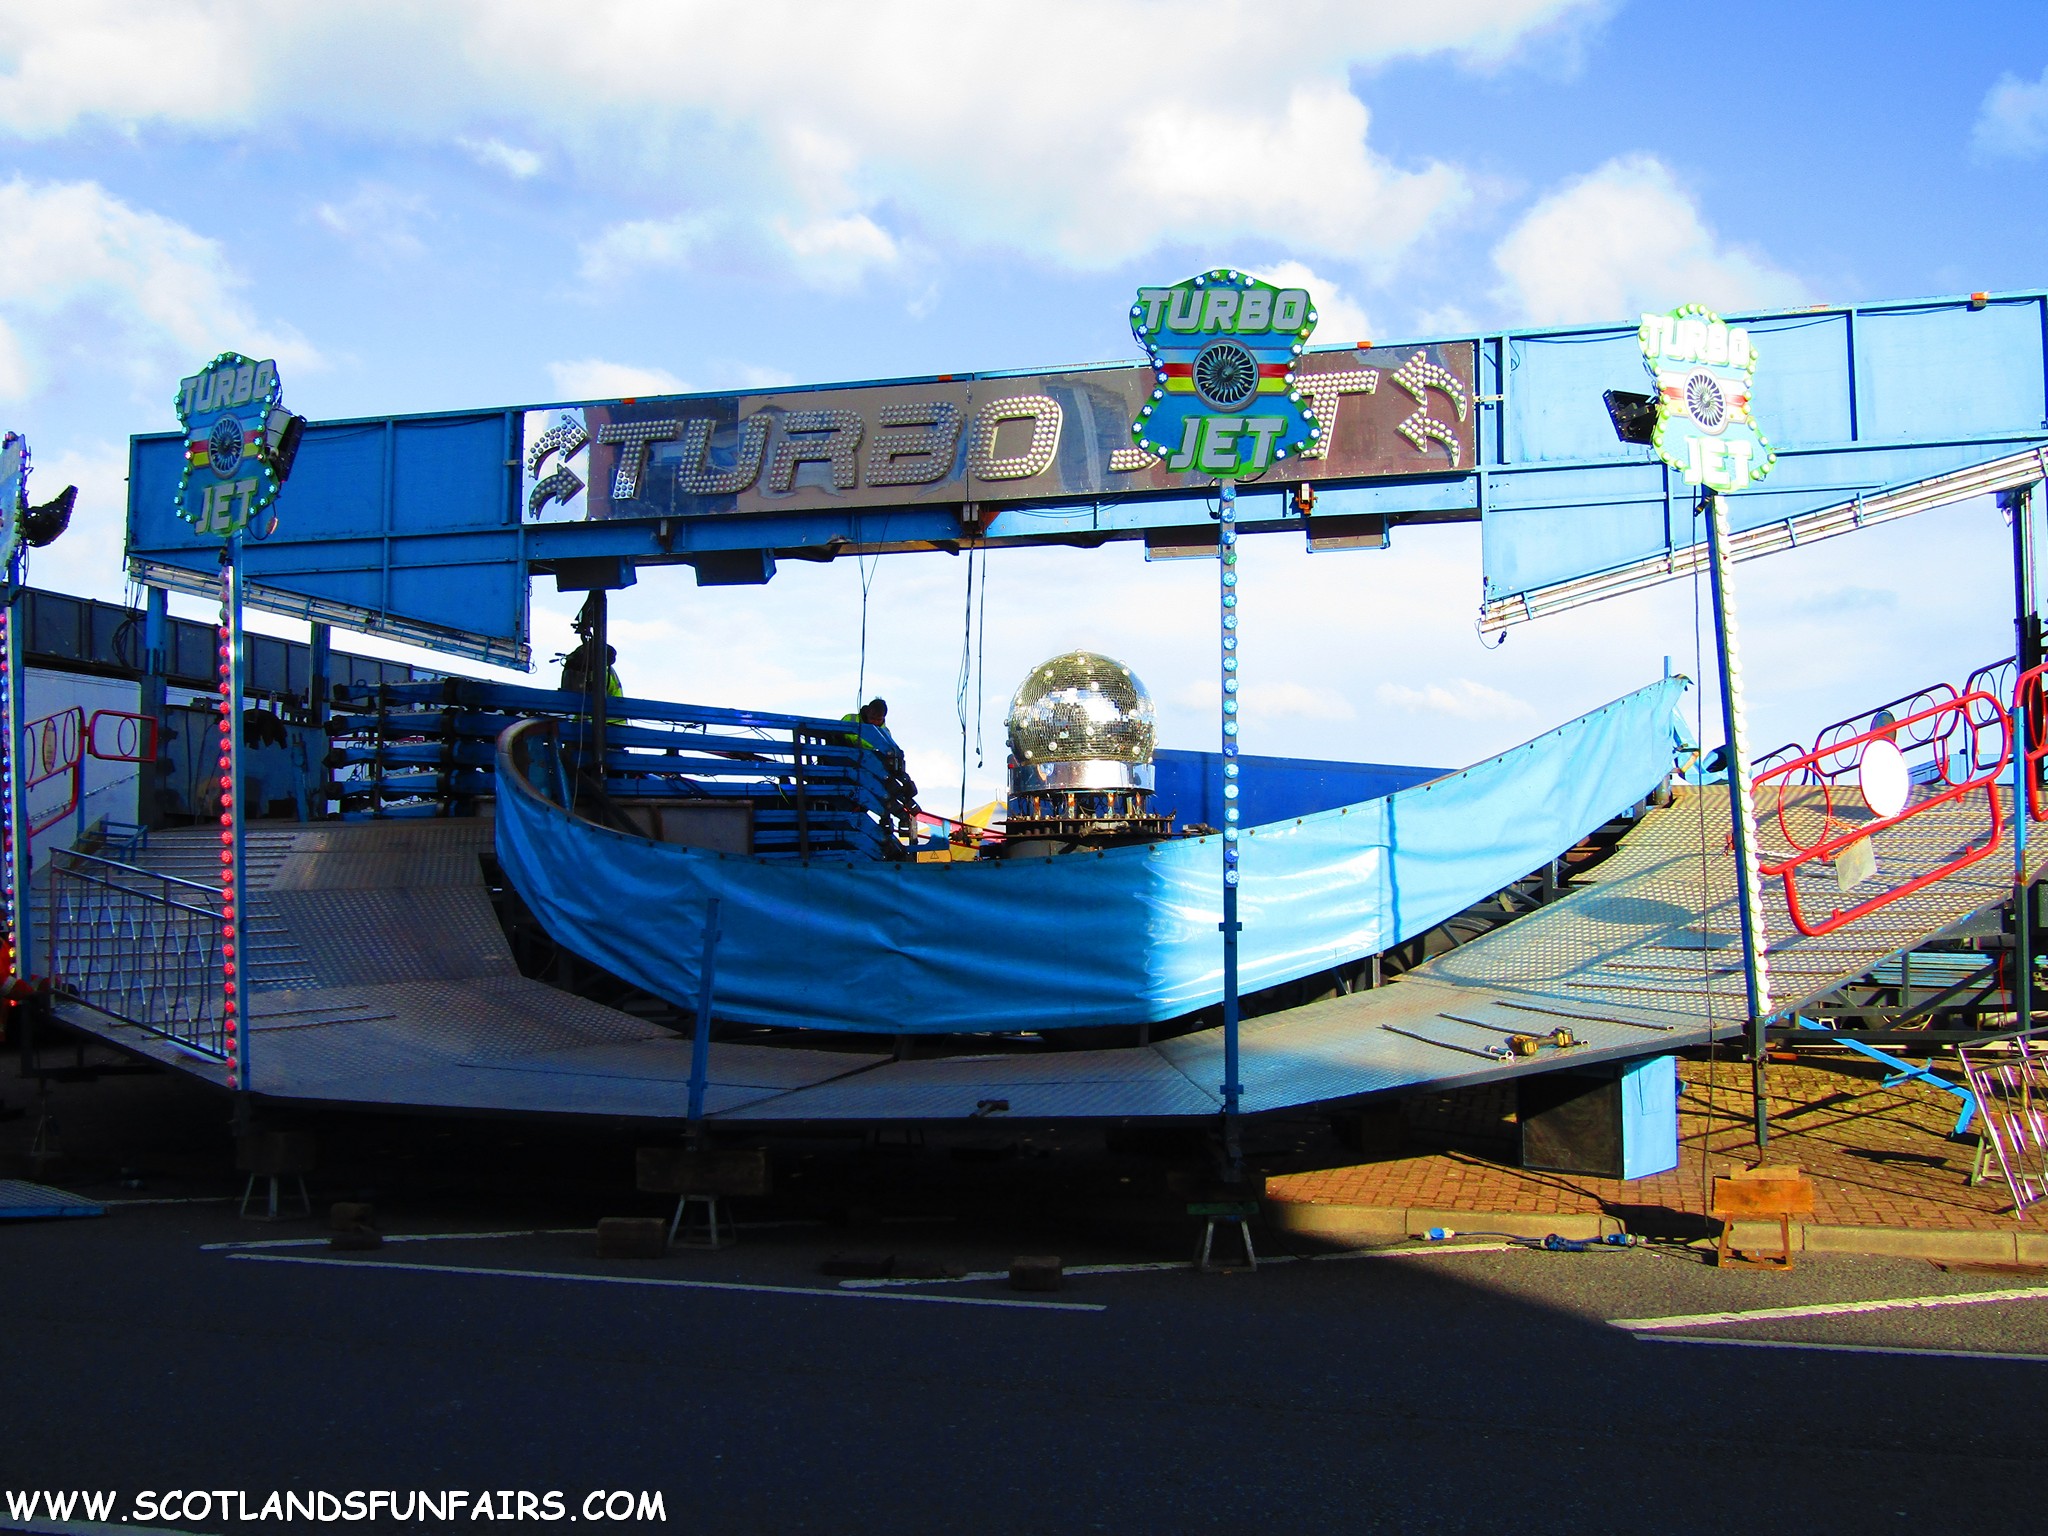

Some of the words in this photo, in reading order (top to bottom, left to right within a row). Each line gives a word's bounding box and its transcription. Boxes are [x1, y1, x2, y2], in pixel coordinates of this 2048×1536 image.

[1140, 289, 1307, 330] TURBO
[1641, 313, 1750, 368] TURBO
[182, 360, 274, 414] TURBO
[596, 394, 1063, 500] TURBO
[1169, 417, 1285, 469] JET
[1683, 435, 1754, 489] JET
[195, 478, 257, 533] JET
